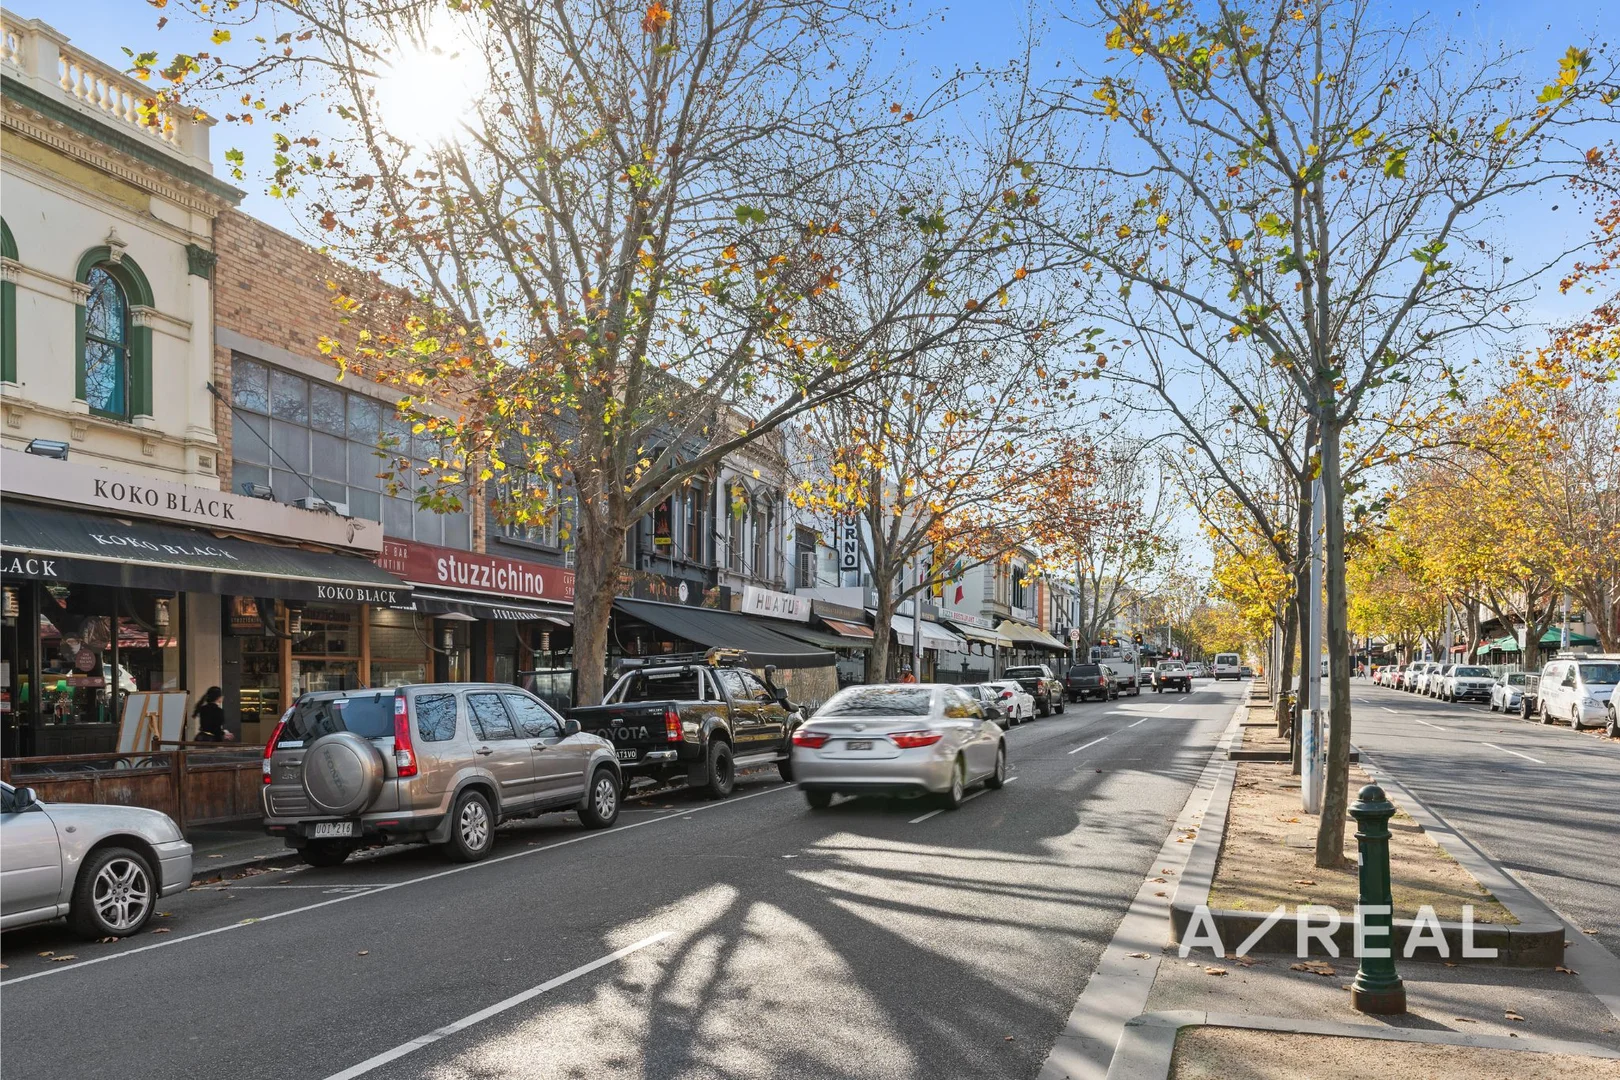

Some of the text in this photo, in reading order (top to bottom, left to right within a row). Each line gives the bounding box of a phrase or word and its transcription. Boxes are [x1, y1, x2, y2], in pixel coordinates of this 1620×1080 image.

[94, 479, 235, 520] KOKO BLACK
[89, 533, 239, 561] KOKO BLACK
[437, 555, 544, 595] stuzzichino
[317, 585, 397, 603] KOKO BLACK
